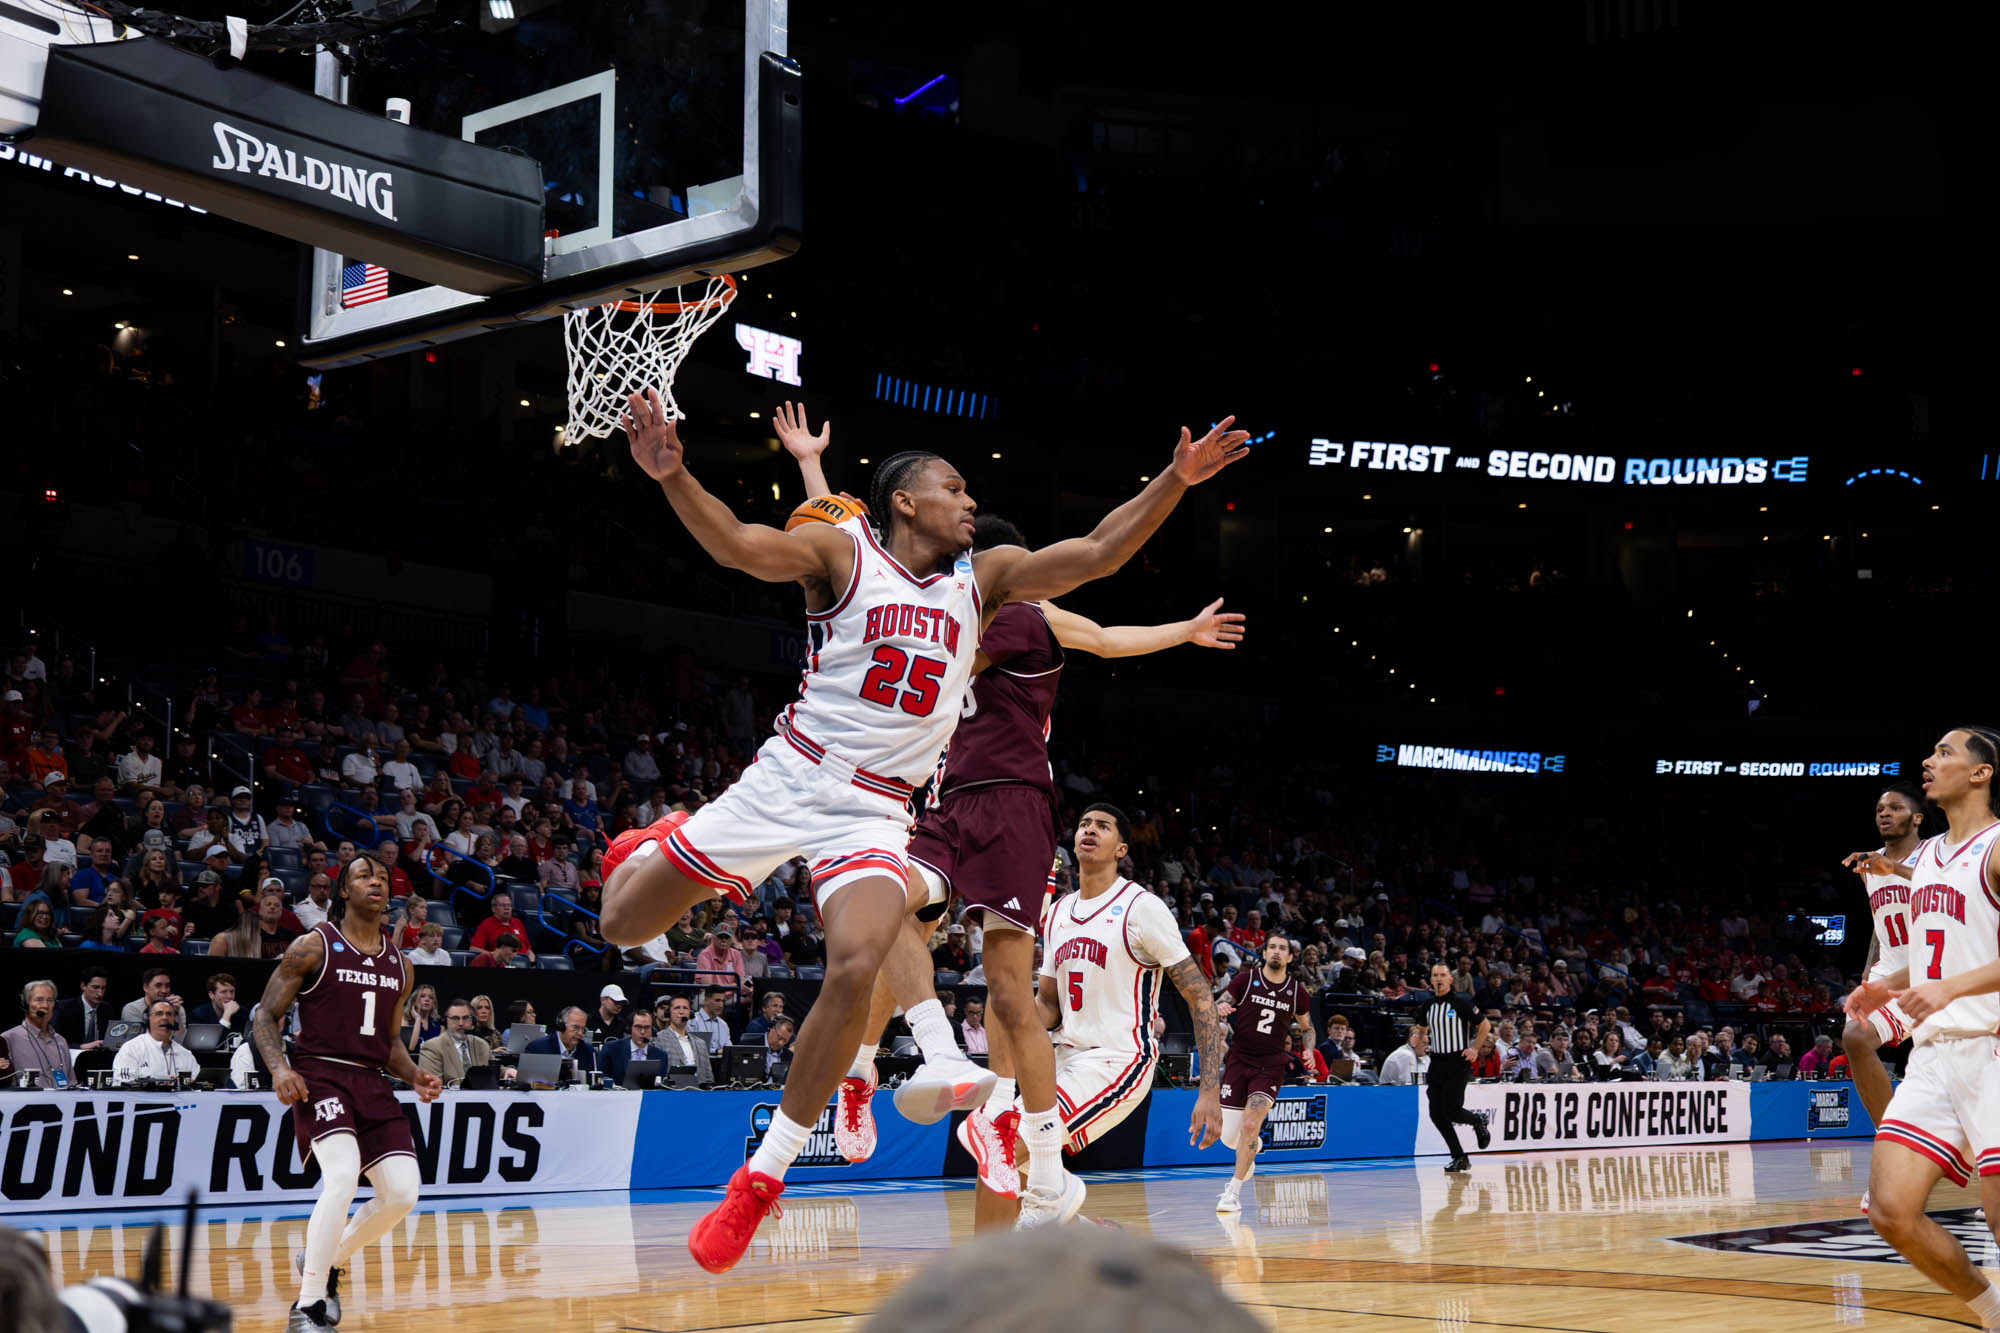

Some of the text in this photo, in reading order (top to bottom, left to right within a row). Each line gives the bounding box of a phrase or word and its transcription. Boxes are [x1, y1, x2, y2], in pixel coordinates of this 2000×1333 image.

[212, 121, 395, 222] SPALDING
[1350, 440, 1768, 485] FIRST AND SECOND ROUNDS
[256, 546, 304, 582] 106
[859, 644, 947, 718] 25
[1675, 760, 1723, 775] FIRST
[1739, 761, 1805, 777] SECOND
[1808, 762, 1881, 777] ROUNDS
[1884, 912, 1910, 948] 11
[1926, 928, 1945, 980] 7
[336, 968, 378, 986] TEXAS
[1068, 971, 1084, 1012] 5
[360, 990, 377, 1036] 1
[1251, 994, 1276, 1008] TEXAS
[1256, 1008, 1276, 1035] 2
[1268, 1102, 1308, 1122] MARCH
[1503, 1092, 1546, 1141] BIG
[1554, 1091, 1579, 1140] 12
[1586, 1090, 1729, 1138] CONFERENCE
[1273, 1120, 1326, 1143] MADNESS
